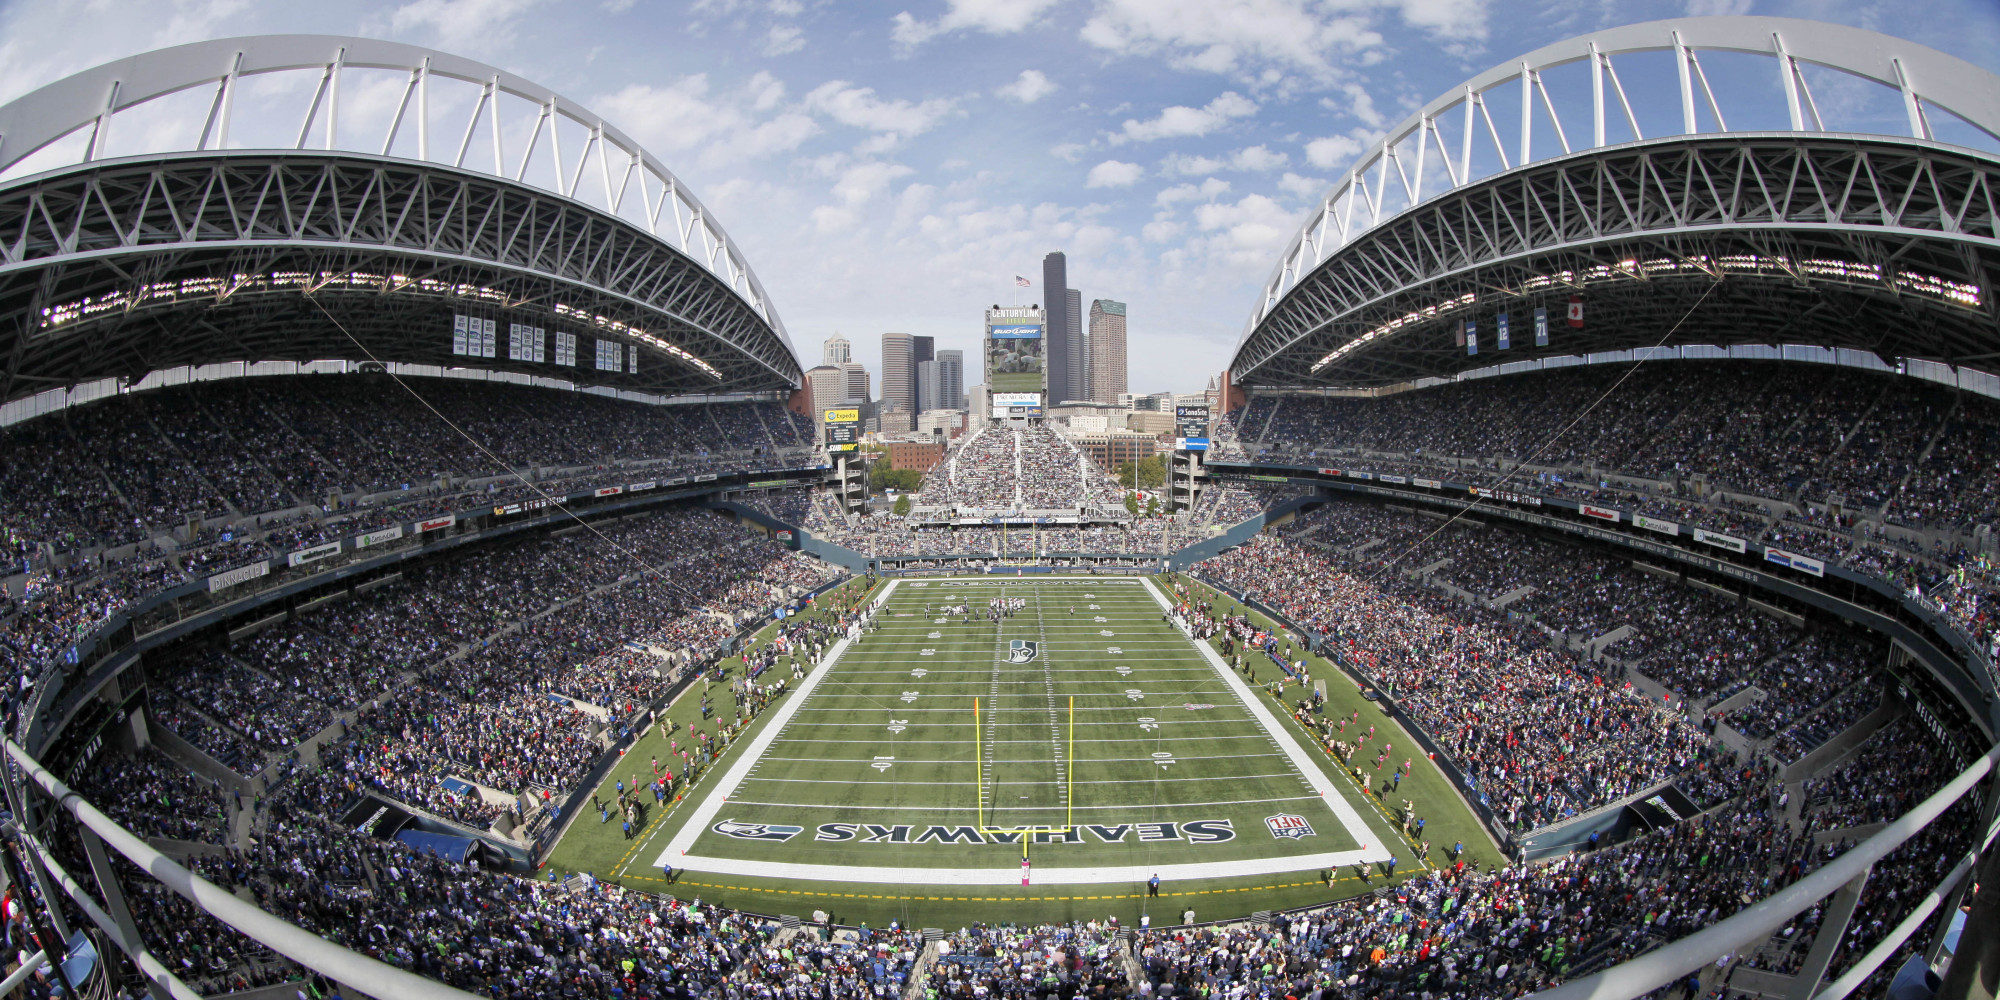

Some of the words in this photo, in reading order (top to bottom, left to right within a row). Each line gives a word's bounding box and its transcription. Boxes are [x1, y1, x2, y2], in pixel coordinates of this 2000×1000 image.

[992, 308, 1040, 318] CENTURYLINK
[1012, 327, 1038, 335] LIGHT
[1499, 327, 1508, 341] 12
[1536, 322, 1547, 337] 71
[1467, 334, 1477, 347] 80
[828, 444, 858, 452] SUBWAY
[1583, 506, 1614, 519] Budweiser
[421, 520, 451, 532] Budweiser
[1645, 521, 1670, 532] CenturyLink
[223, 532, 233, 542] 12
[371, 530, 397, 543] CenturyLink
[215, 566, 261, 590] PINNACLE
[1916, 700, 1946, 744] WELCOME
[1947, 740, 1955, 759] TO
[87, 734, 103, 760] MAN
[1269, 815, 1306, 829] NFL
[813, 818, 1237, 846] SEAHAWKS
